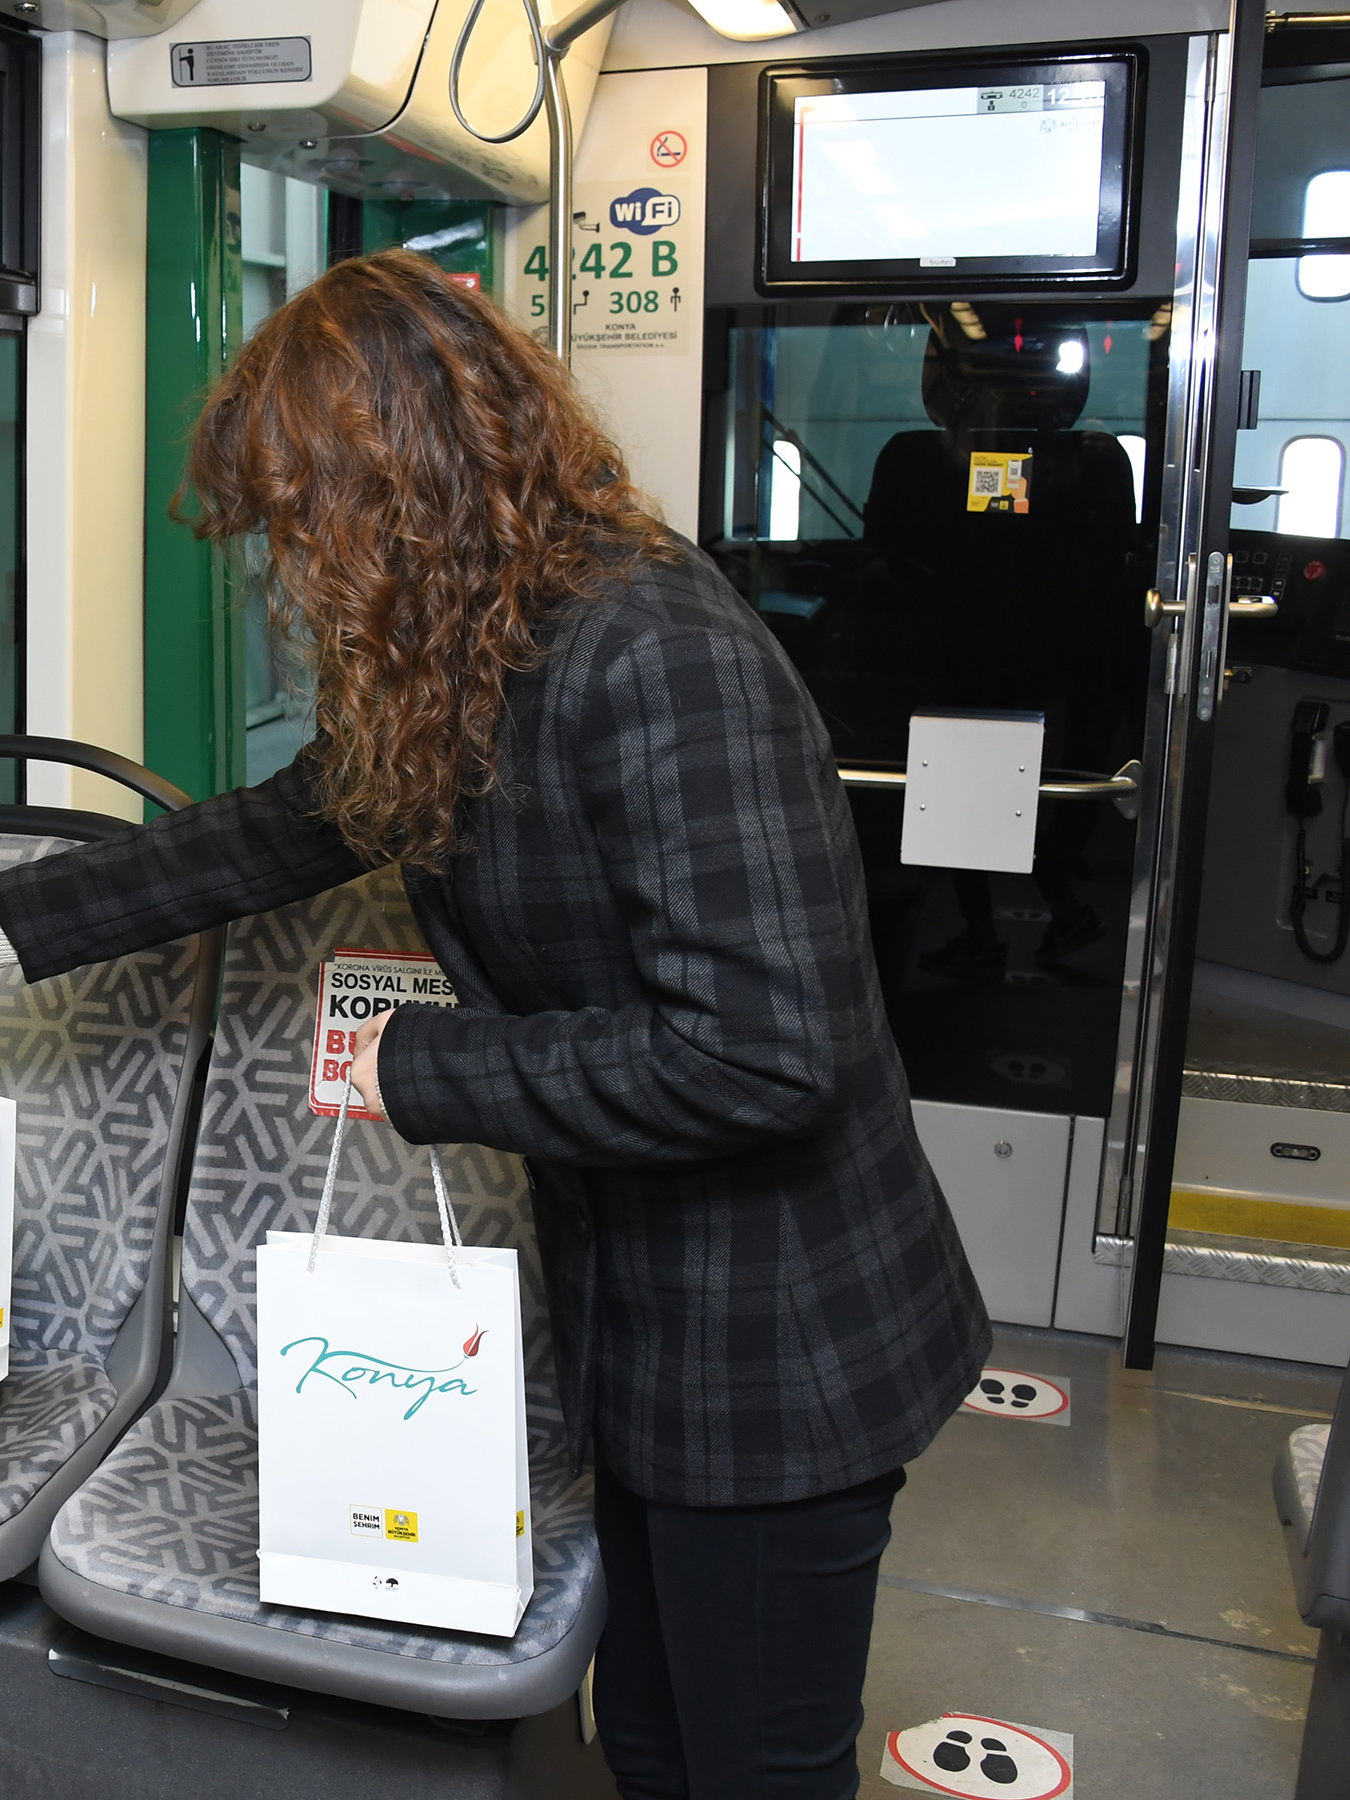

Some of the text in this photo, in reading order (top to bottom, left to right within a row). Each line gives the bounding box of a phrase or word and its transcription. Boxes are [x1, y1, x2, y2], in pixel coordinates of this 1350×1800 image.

[1009, 87, 1040, 99] 4242
[1021, 101, 1027, 109] 0
[523, 240, 678, 282] 442 B
[609, 290, 659, 314] 308
[605, 323, 636, 331] KONYA
[570, 330, 677, 343] ÜYÜKŞEHİR BELEDİYESİ
[393, 967, 422, 975] SALGINI
[331, 972, 454, 996] SOSYAL MES
[280, 1336, 477, 1421] Konya
